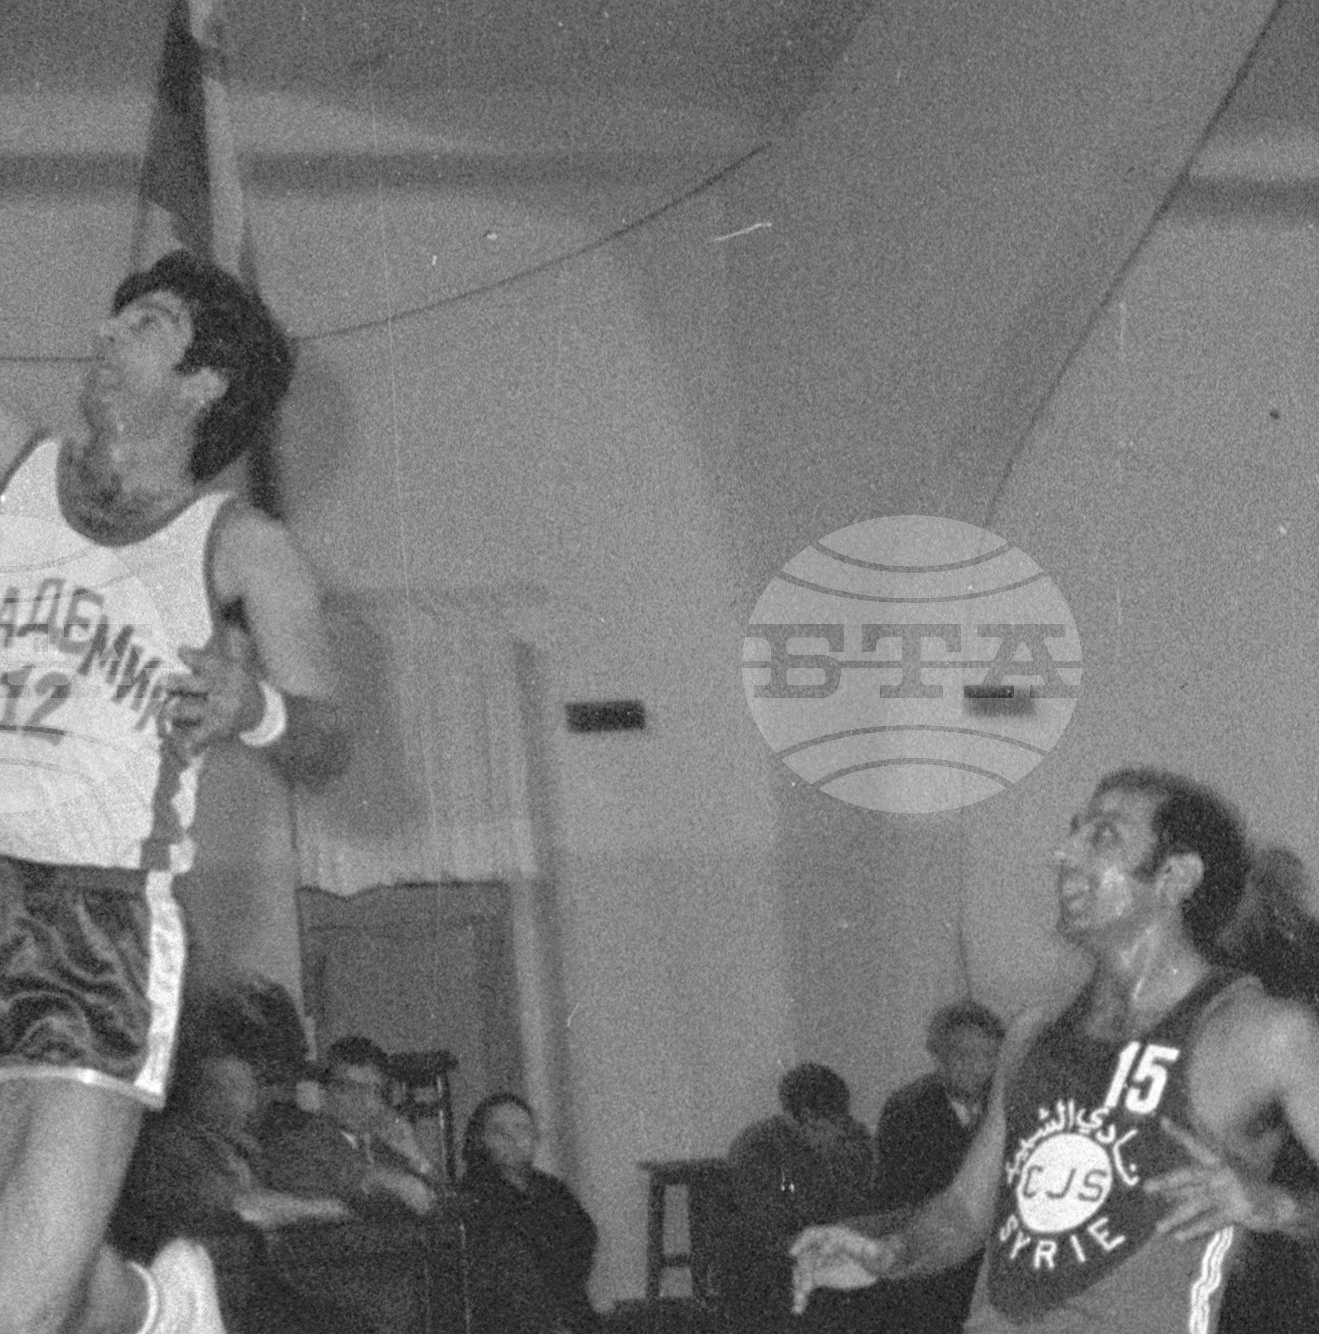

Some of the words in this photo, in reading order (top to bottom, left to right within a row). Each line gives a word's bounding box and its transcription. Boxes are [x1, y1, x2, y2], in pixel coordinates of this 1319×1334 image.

[1104, 1040, 1180, 1114] 15
[1023, 1165, 1110, 1202] CJS
[999, 1215, 1126, 1269] SYRIE
